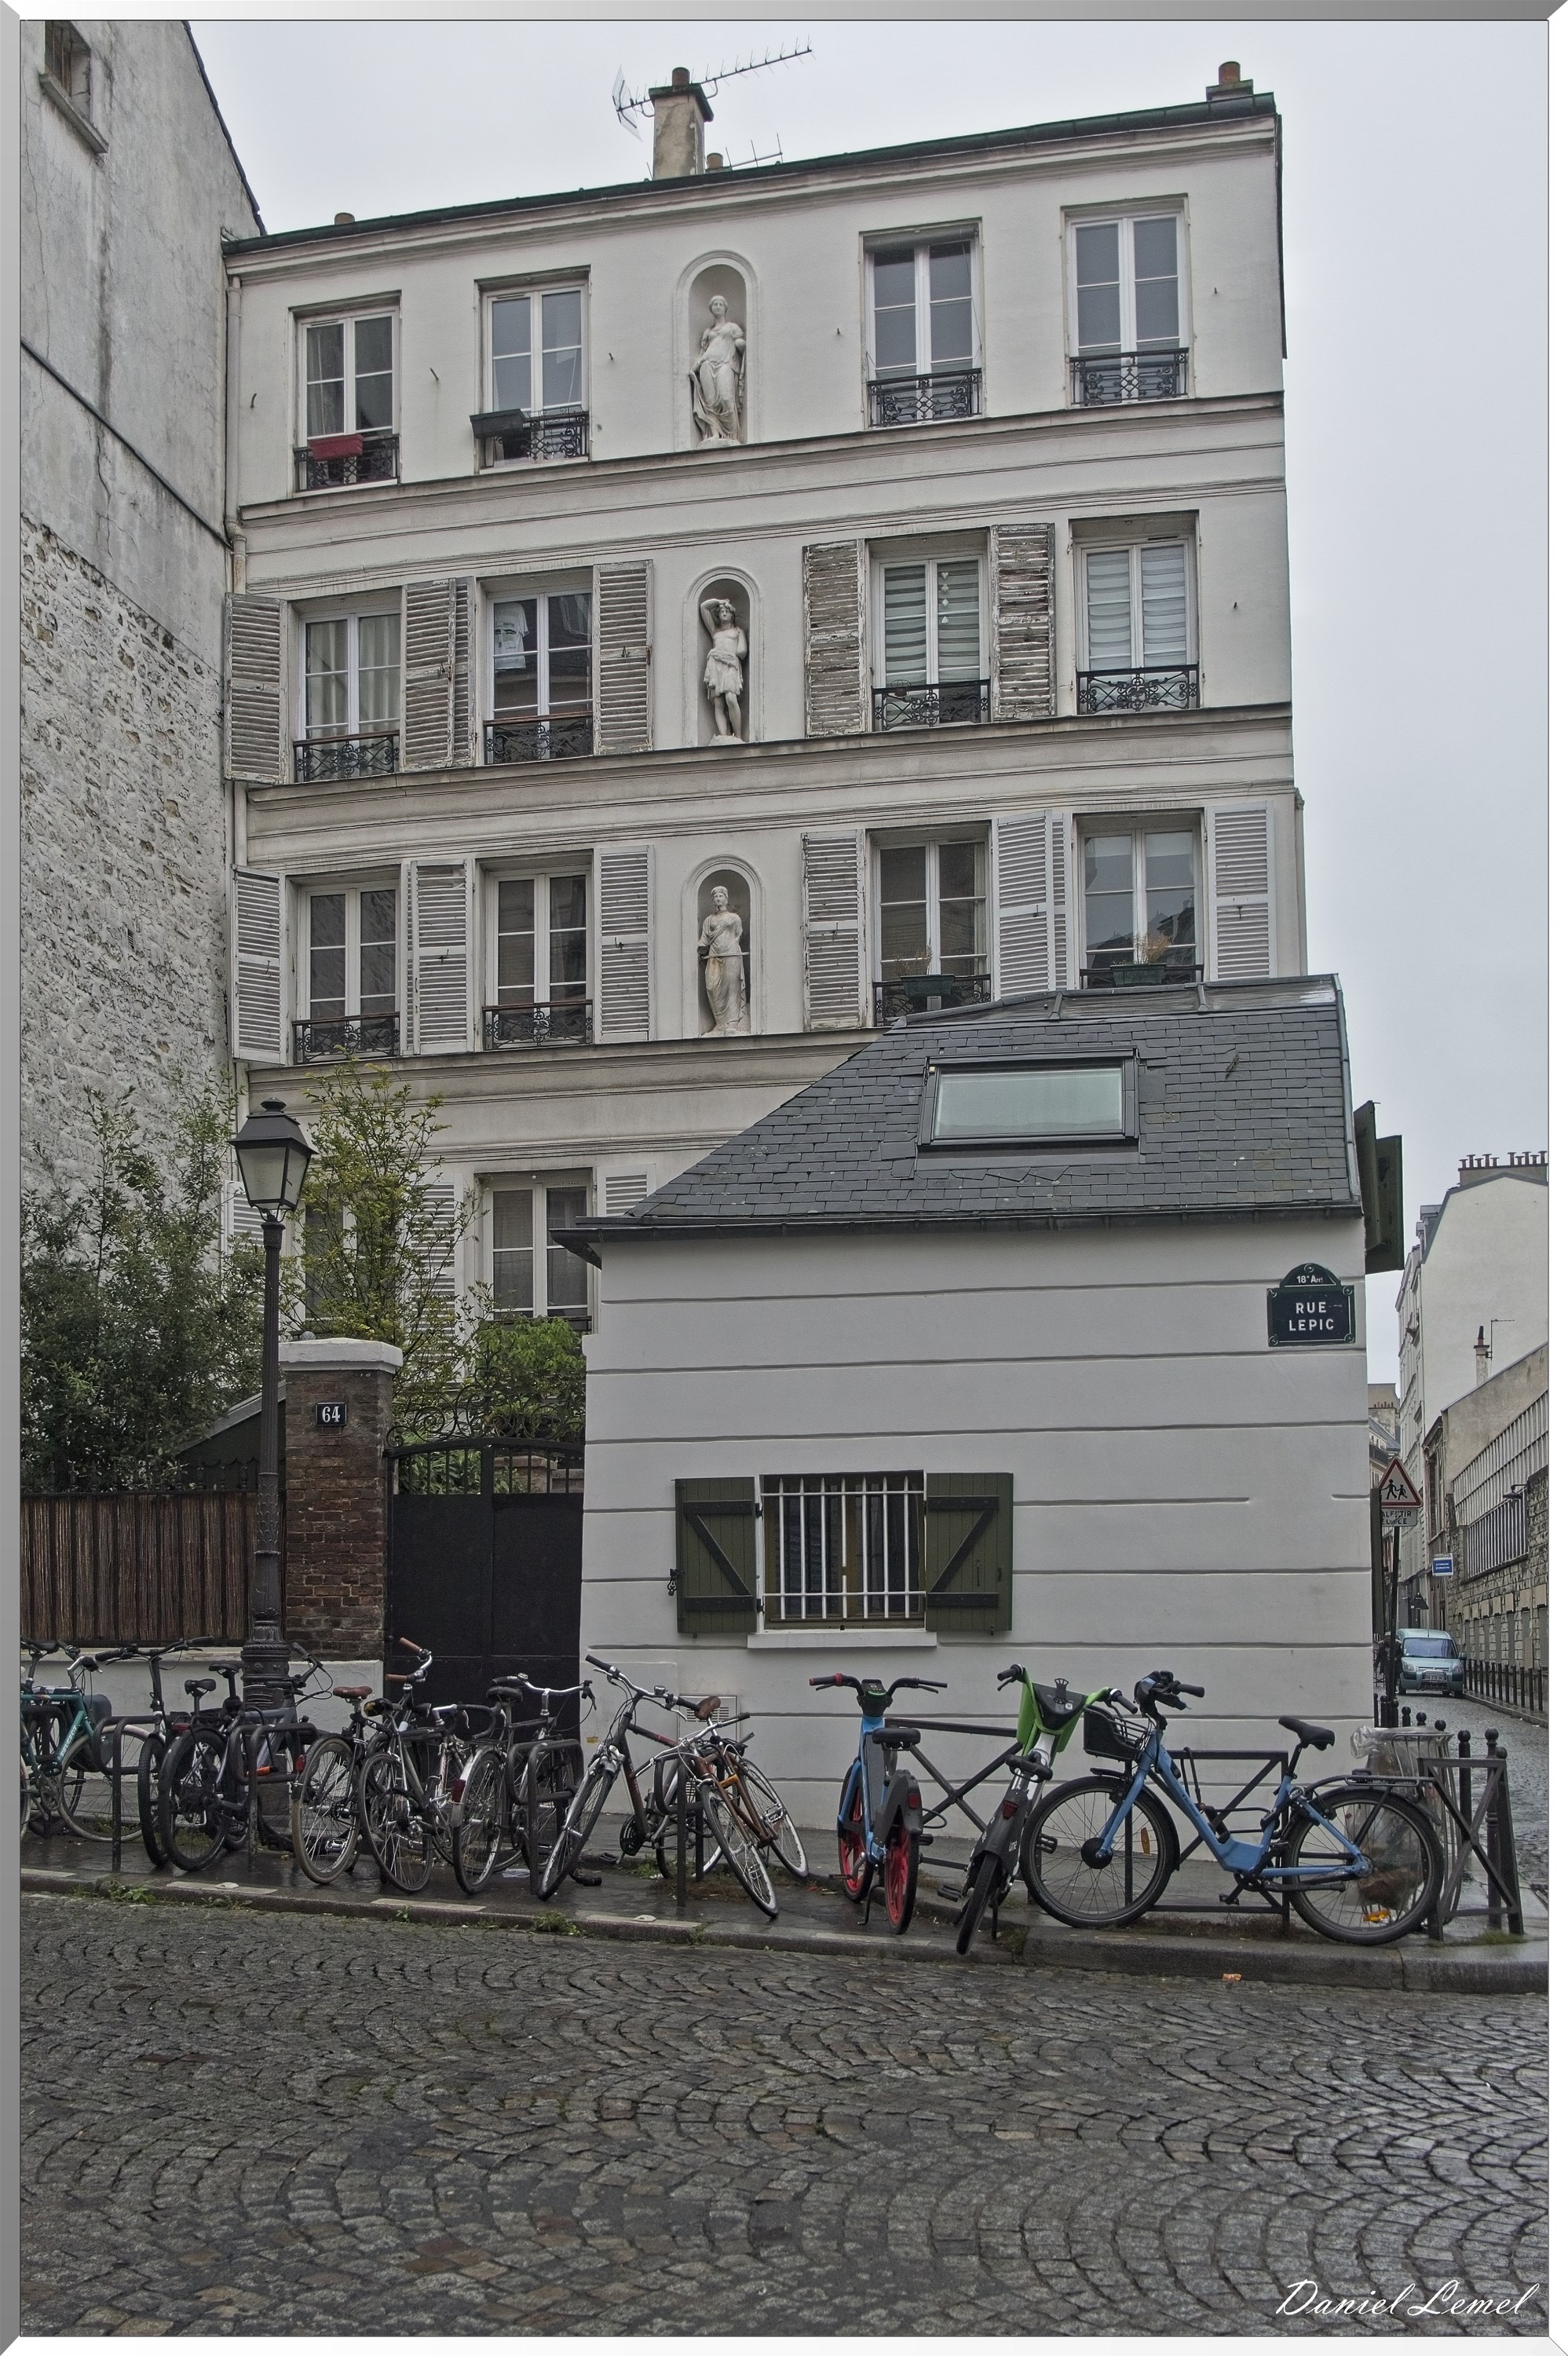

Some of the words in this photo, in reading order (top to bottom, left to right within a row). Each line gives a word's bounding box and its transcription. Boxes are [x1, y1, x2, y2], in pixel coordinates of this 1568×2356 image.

[1296, 1301, 1327, 1314] RUE
[1288, 1319, 1334, 1331] LEPIC
[322, 1406, 341, 1423] 64
